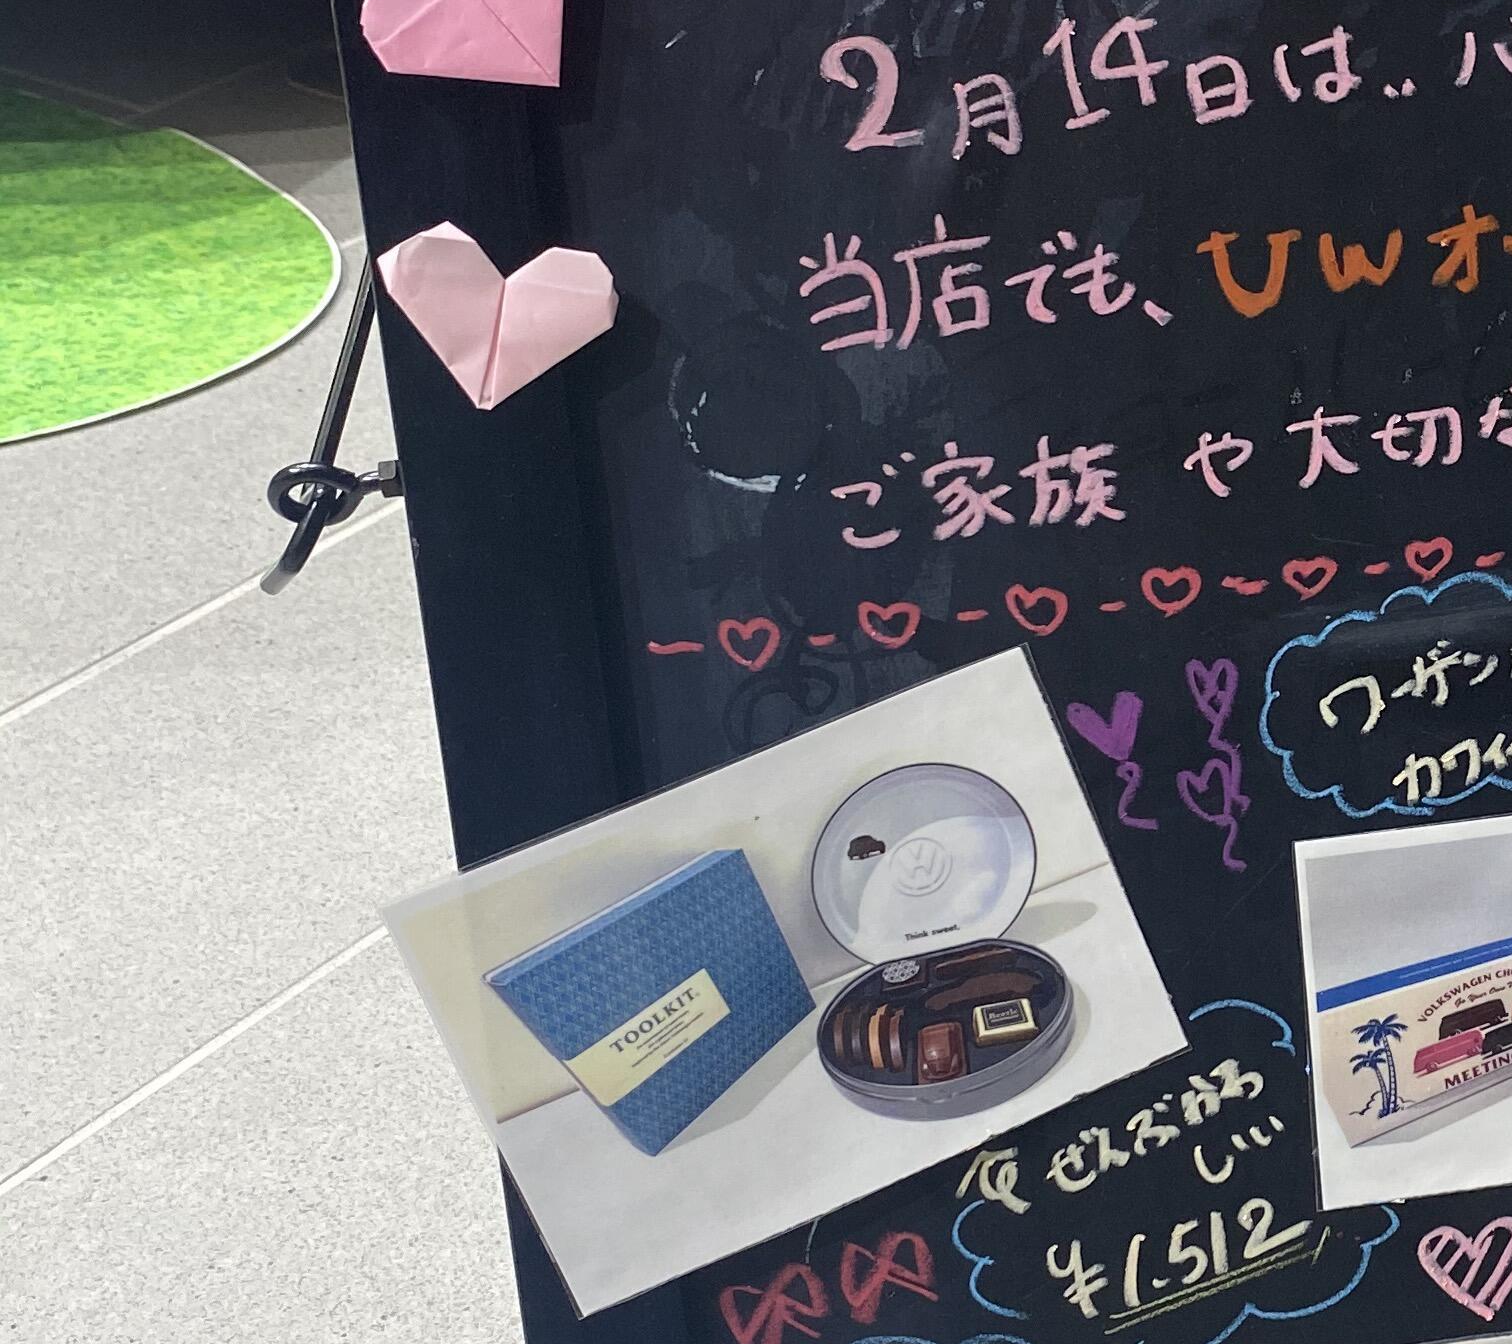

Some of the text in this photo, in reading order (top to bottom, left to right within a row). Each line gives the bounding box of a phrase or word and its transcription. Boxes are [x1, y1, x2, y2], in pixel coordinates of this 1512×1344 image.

[905, 930, 929, 942] Think
[609, 987, 697, 1053] TOOLKIT
[1417, 973, 1492, 1024] VOLKSWAGEN
